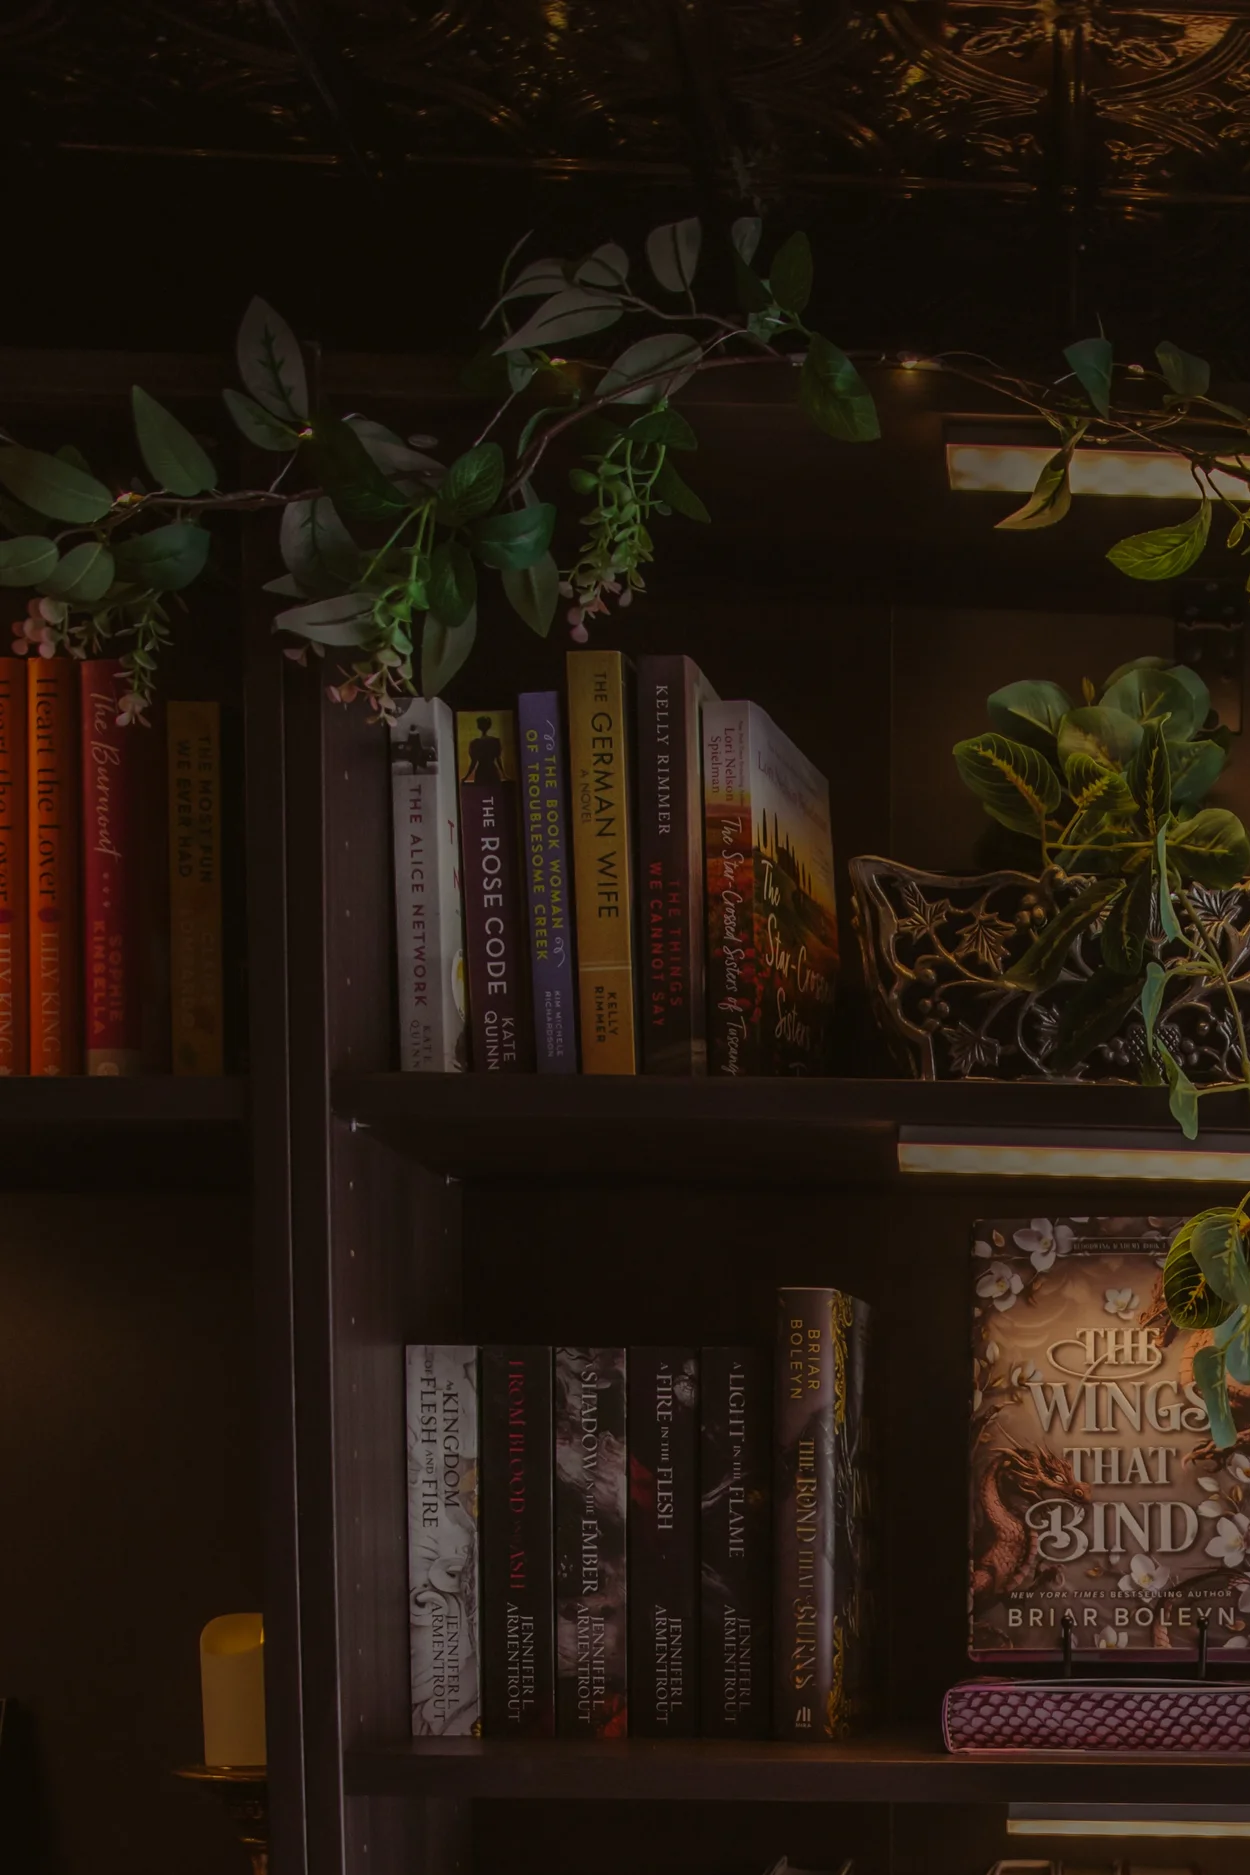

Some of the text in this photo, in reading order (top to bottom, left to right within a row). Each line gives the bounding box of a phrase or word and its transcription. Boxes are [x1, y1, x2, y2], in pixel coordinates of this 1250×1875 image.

[37, 678, 60, 900] Heart the Lover
[410, 785, 421, 824] THE
[591, 673, 619, 918] THE GERMAN WIFE
[656, 685, 670, 835] KELLY RIMMER
[410, 835, 425, 894] ALICE
[526, 731, 548, 960] OF TROUBLESOME CREEK
[545, 755, 564, 929] THE BOOK WOMAN
[480, 797, 506, 995] THE ROSE CODE
[413, 905, 427, 1006] NETWORK
[1046, 1327, 1162, 1378] THE
[420, 1377, 439, 1528] FLESH AND FIRE
[442, 1390, 461, 1508] KINGDOM
[1026, 1381, 1211, 1432] WINGS
[1062, 1447, 1177, 1485] THAT
[1025, 1499, 1199, 1562] BIND
[1008, 1608, 1236, 1627] BRIAR BOLEYN
[1011, 1589, 1232, 1599] NEW YORK TIMES BESTSELLING AUTHOR
